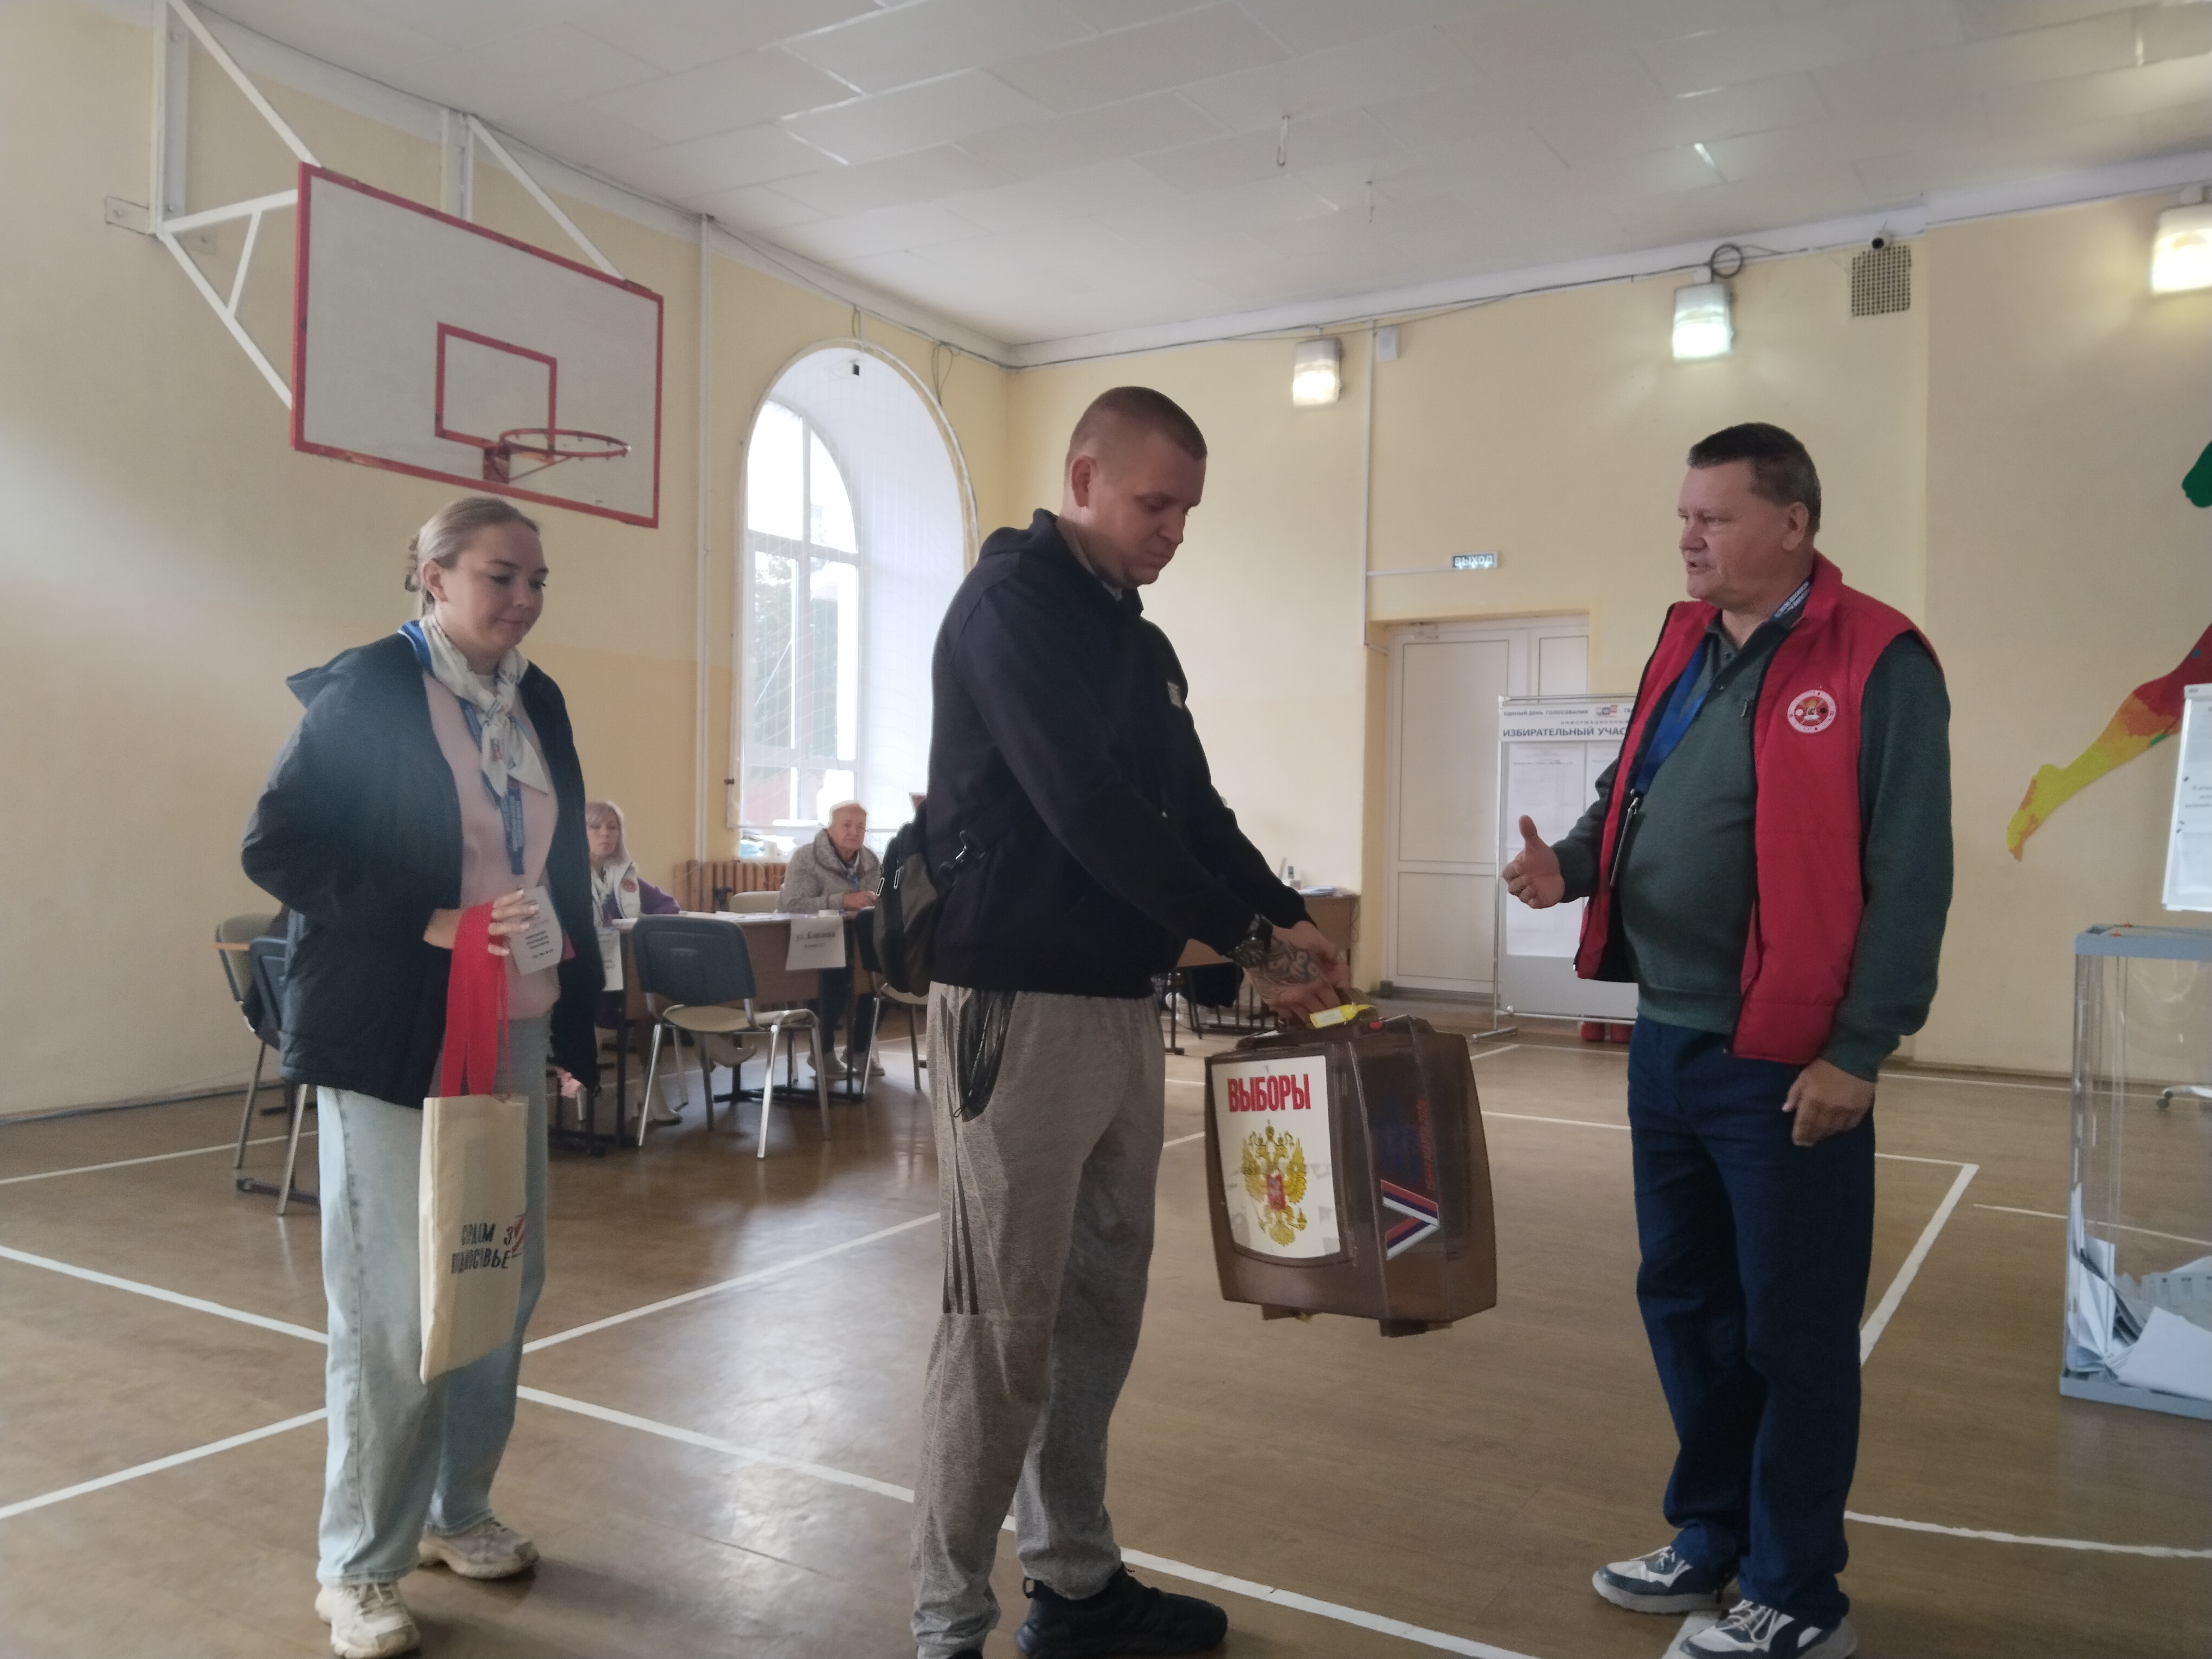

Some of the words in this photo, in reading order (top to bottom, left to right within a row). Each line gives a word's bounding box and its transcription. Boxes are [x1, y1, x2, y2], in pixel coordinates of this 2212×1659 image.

[1454, 555, 1494, 567] ВЫХОД
[1503, 726, 1594, 737] ИЗБИРАТЕЛЬНЫЙ
[1227, 1073, 1311, 1113] ВЫБОРЫ
